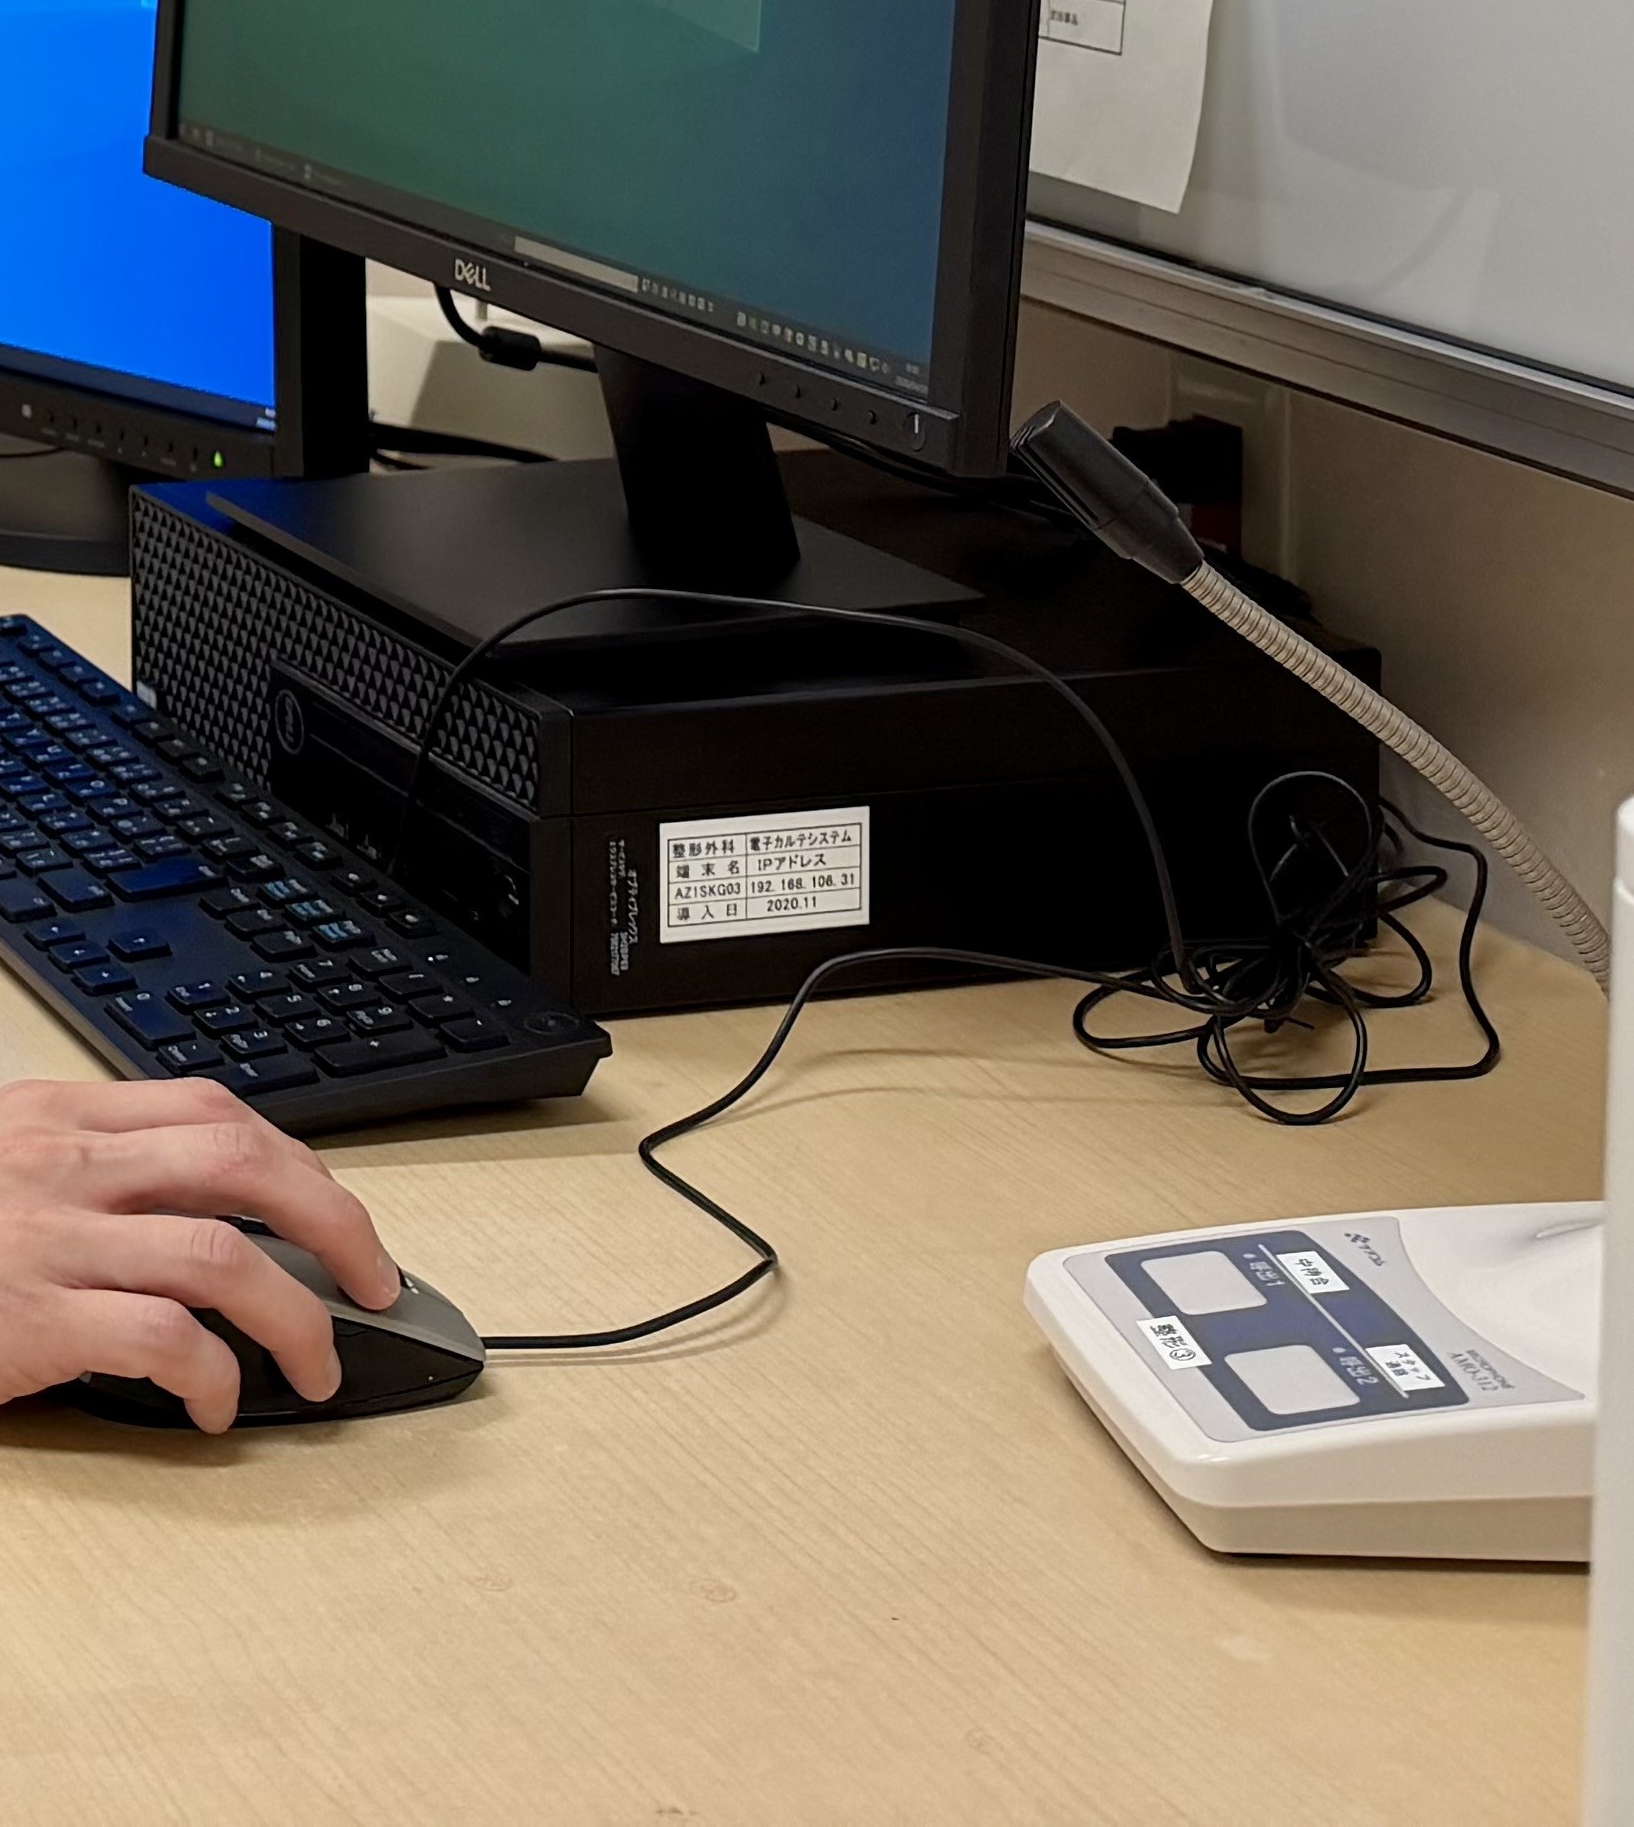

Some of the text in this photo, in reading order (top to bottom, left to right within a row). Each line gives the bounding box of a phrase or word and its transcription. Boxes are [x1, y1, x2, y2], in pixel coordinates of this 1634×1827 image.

[454, 258, 491, 291] DELL
[672, 829, 852, 859] 整形外科 電子カルテシステム
[757, 853, 827, 872] IPアドレス
[766, 895, 818, 912] 2020.11
[1392, 1348, 1431, 1383] スタッフ
